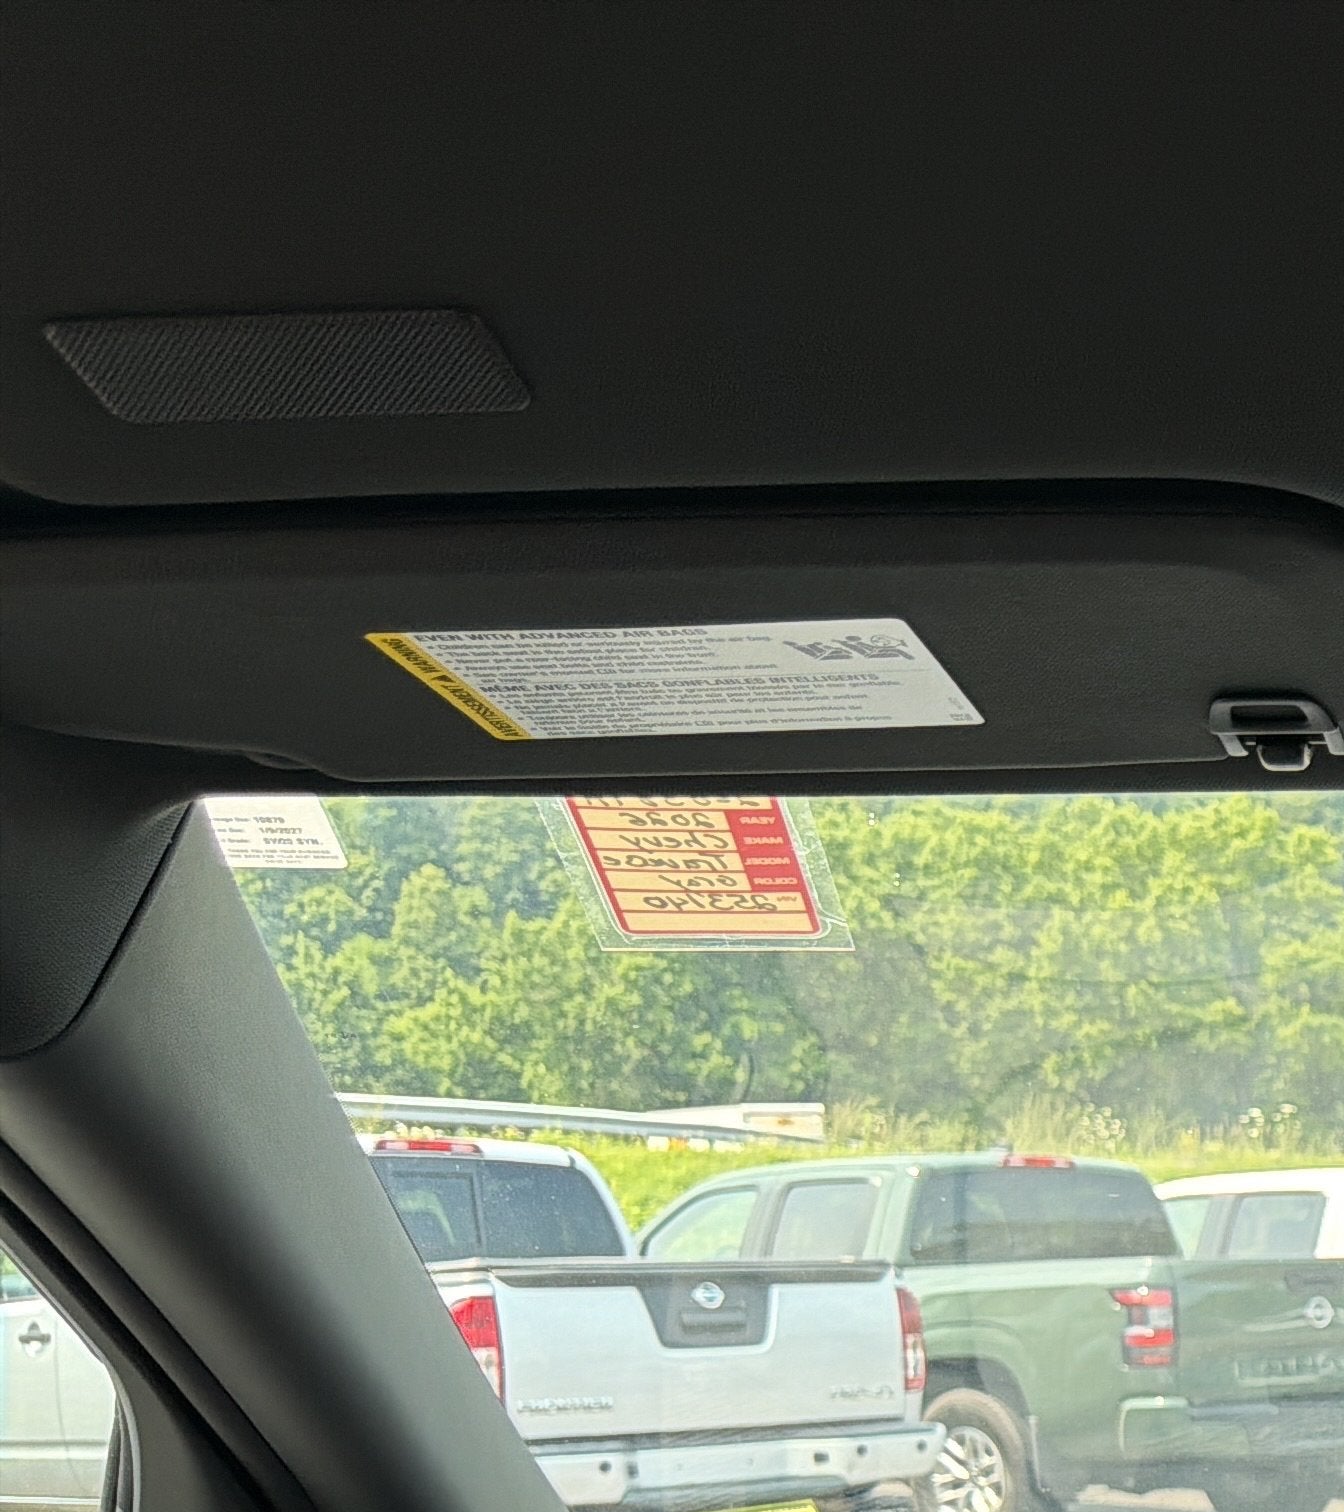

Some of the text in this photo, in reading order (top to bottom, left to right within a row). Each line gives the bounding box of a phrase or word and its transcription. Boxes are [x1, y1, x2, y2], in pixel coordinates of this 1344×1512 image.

[415, 634, 463, 642] EVEN
[464, 633, 515, 641] WITH
[518, 631, 617, 640] ADVANCED
